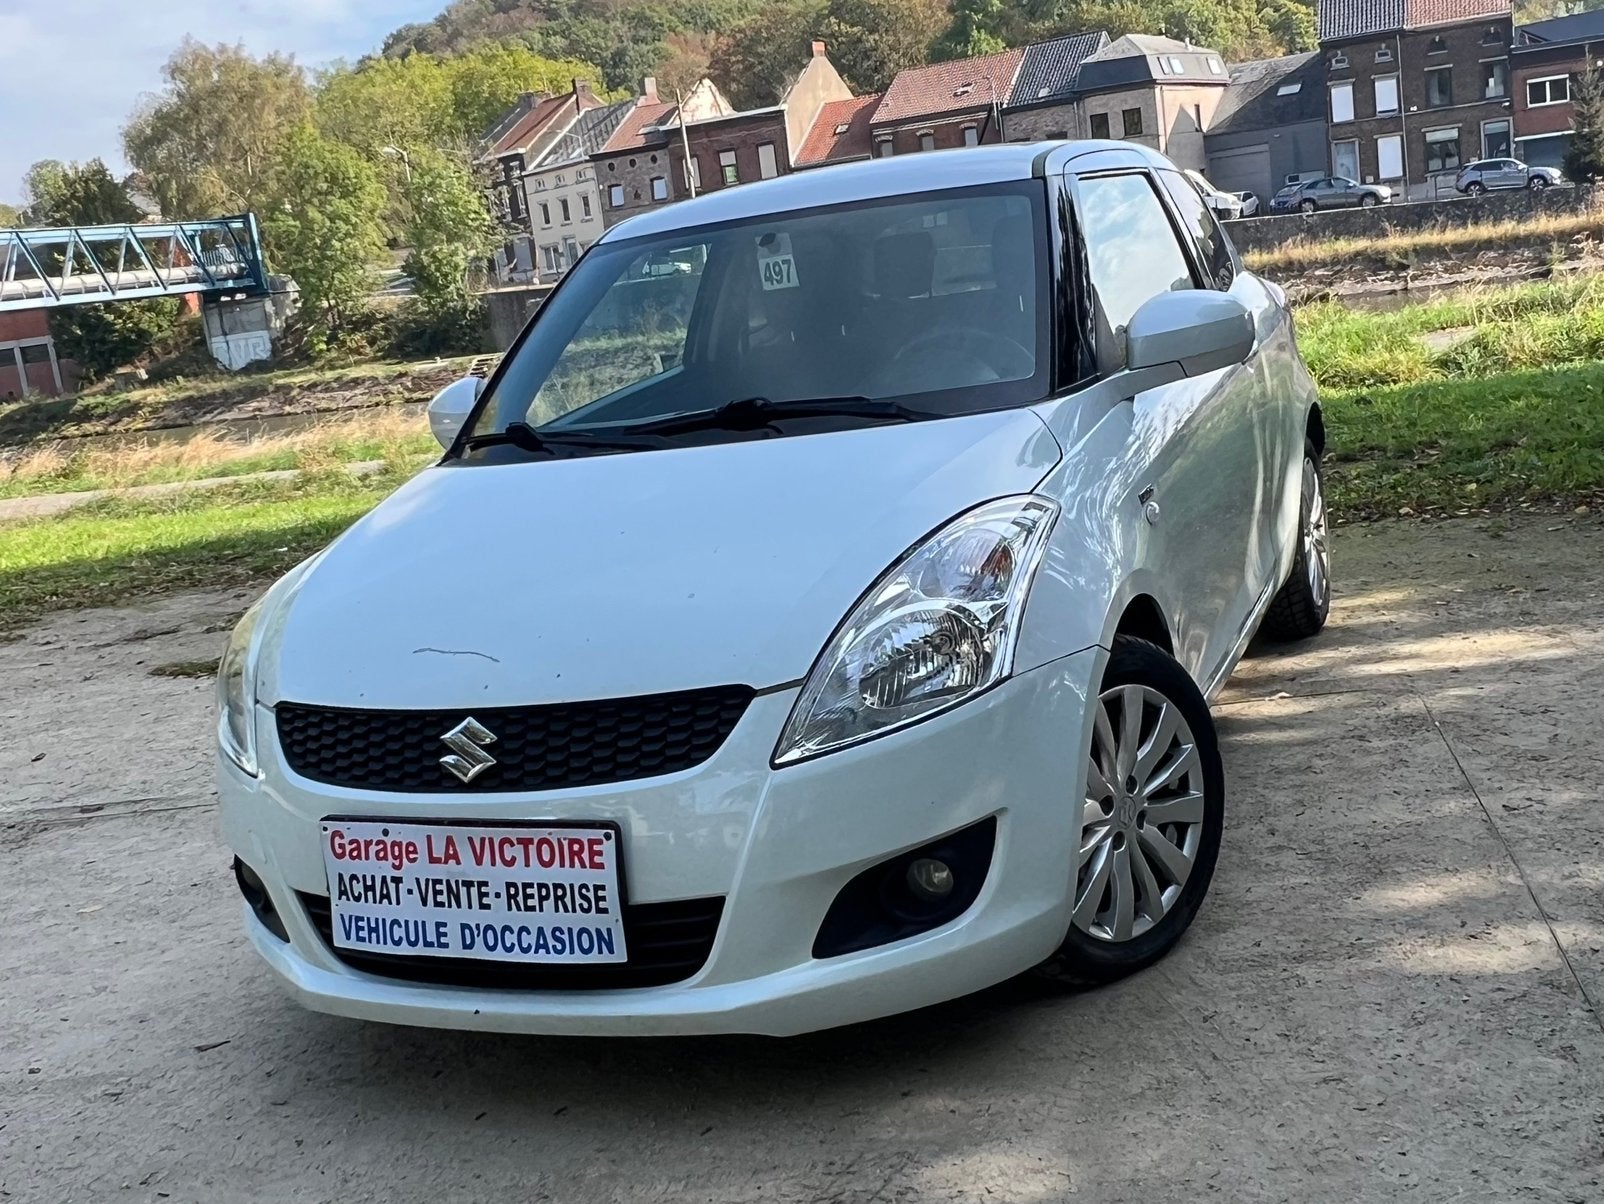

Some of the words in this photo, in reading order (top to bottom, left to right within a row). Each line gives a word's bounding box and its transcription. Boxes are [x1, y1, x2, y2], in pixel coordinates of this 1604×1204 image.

[763, 258, 792, 286] 497
[330, 829, 419, 871] Garage
[426, 833, 462, 866] LA
[467, 835, 606, 870] VICTOIRE
[340, 912, 450, 950] VEHICULE
[460, 922, 616, 956] D'OCCASION
